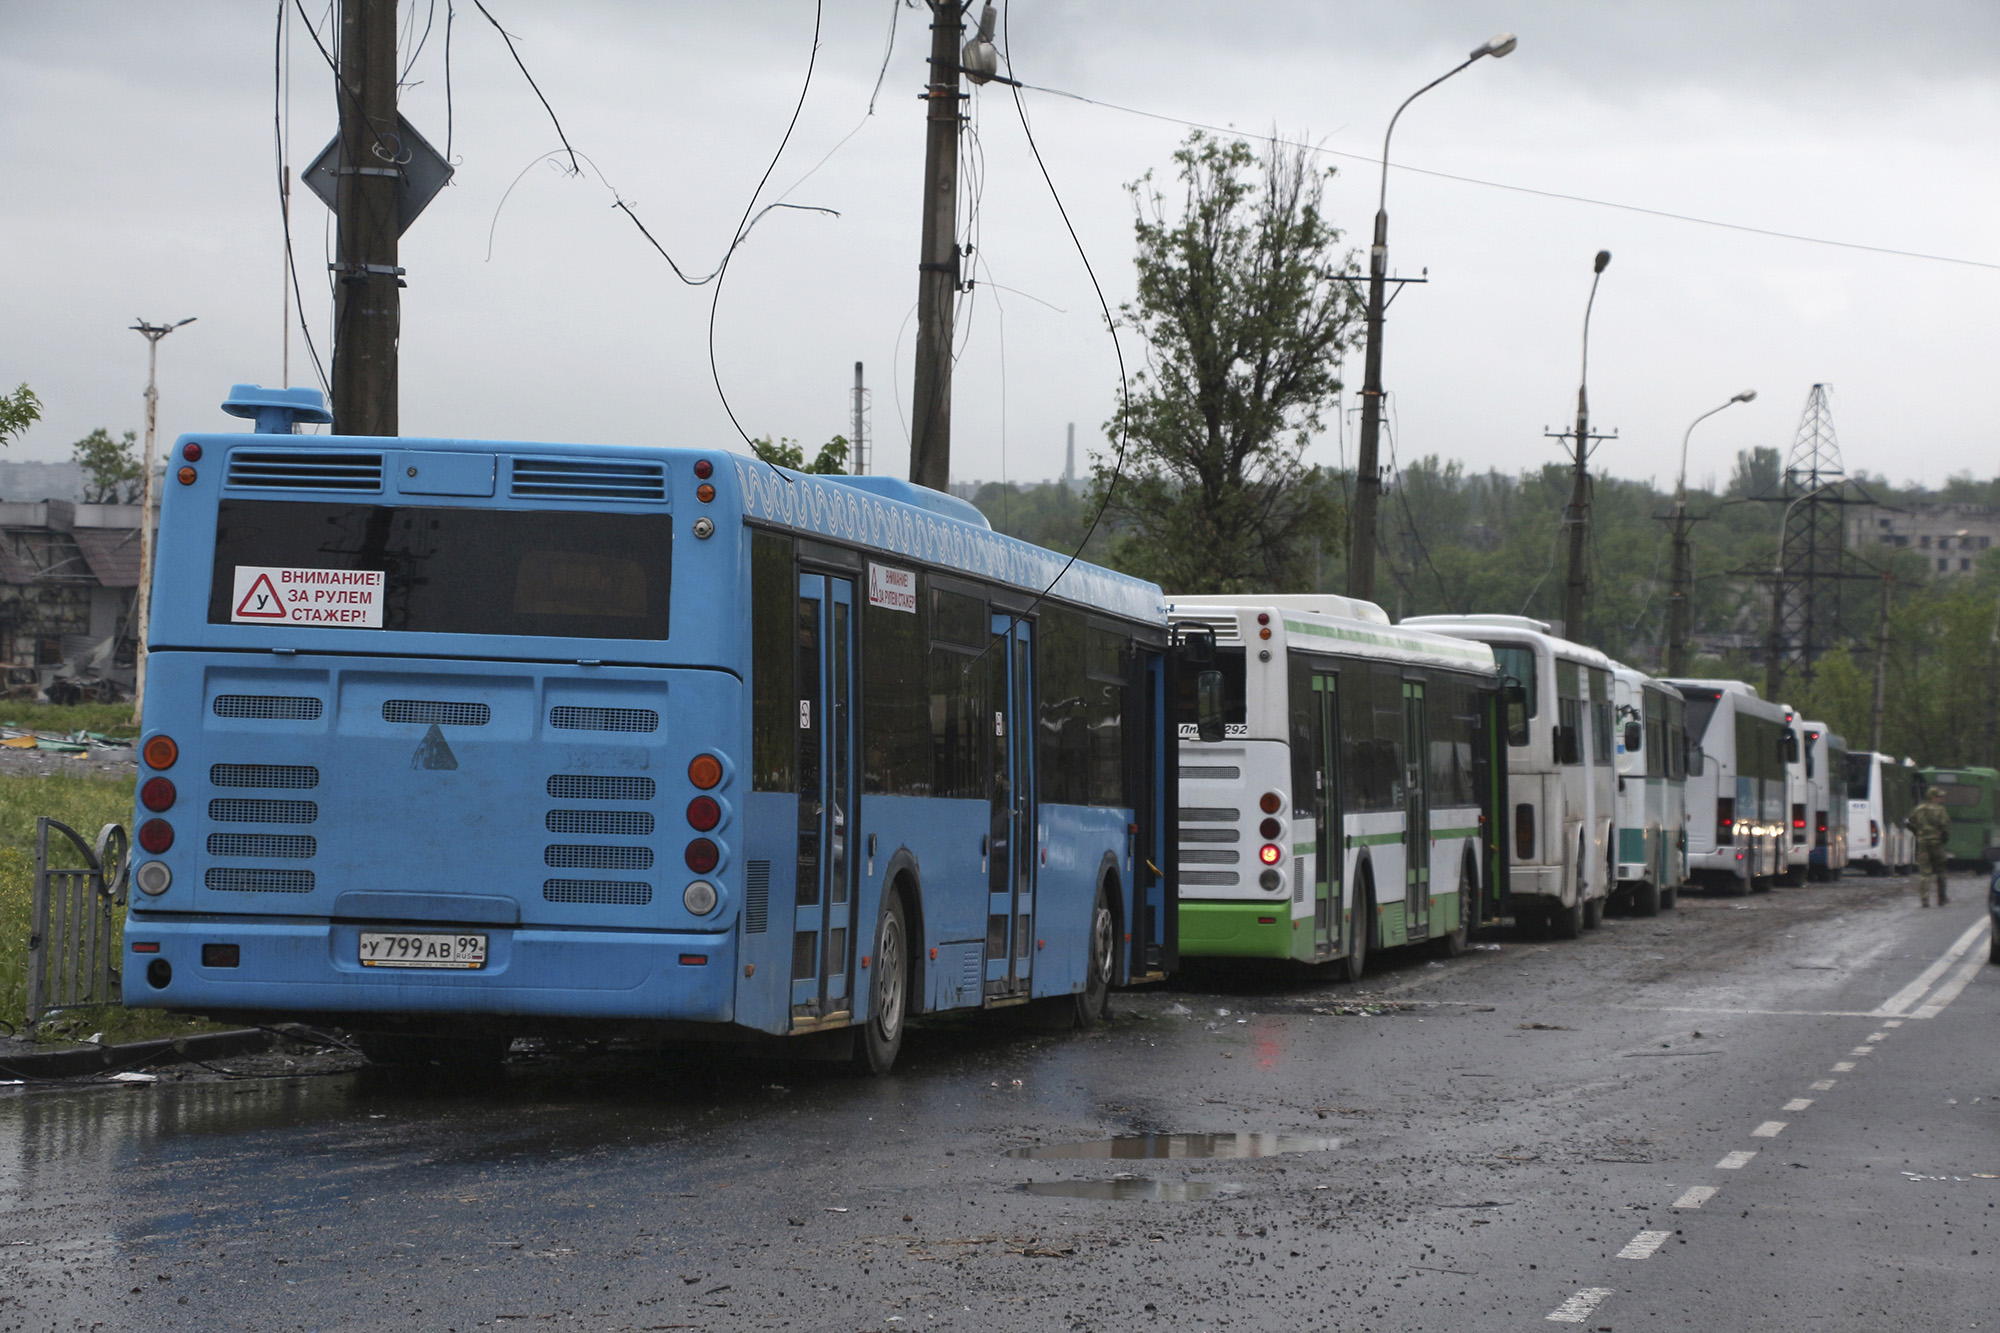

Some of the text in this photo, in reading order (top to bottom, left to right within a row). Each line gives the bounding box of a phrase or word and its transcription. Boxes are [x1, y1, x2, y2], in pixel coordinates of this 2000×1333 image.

[281, 570, 381, 586] ВНИМАНИЕ!
[287, 589, 372, 604] ЗА РУЛЕМ
[291, 608, 366, 622] СТАЖЕР!
